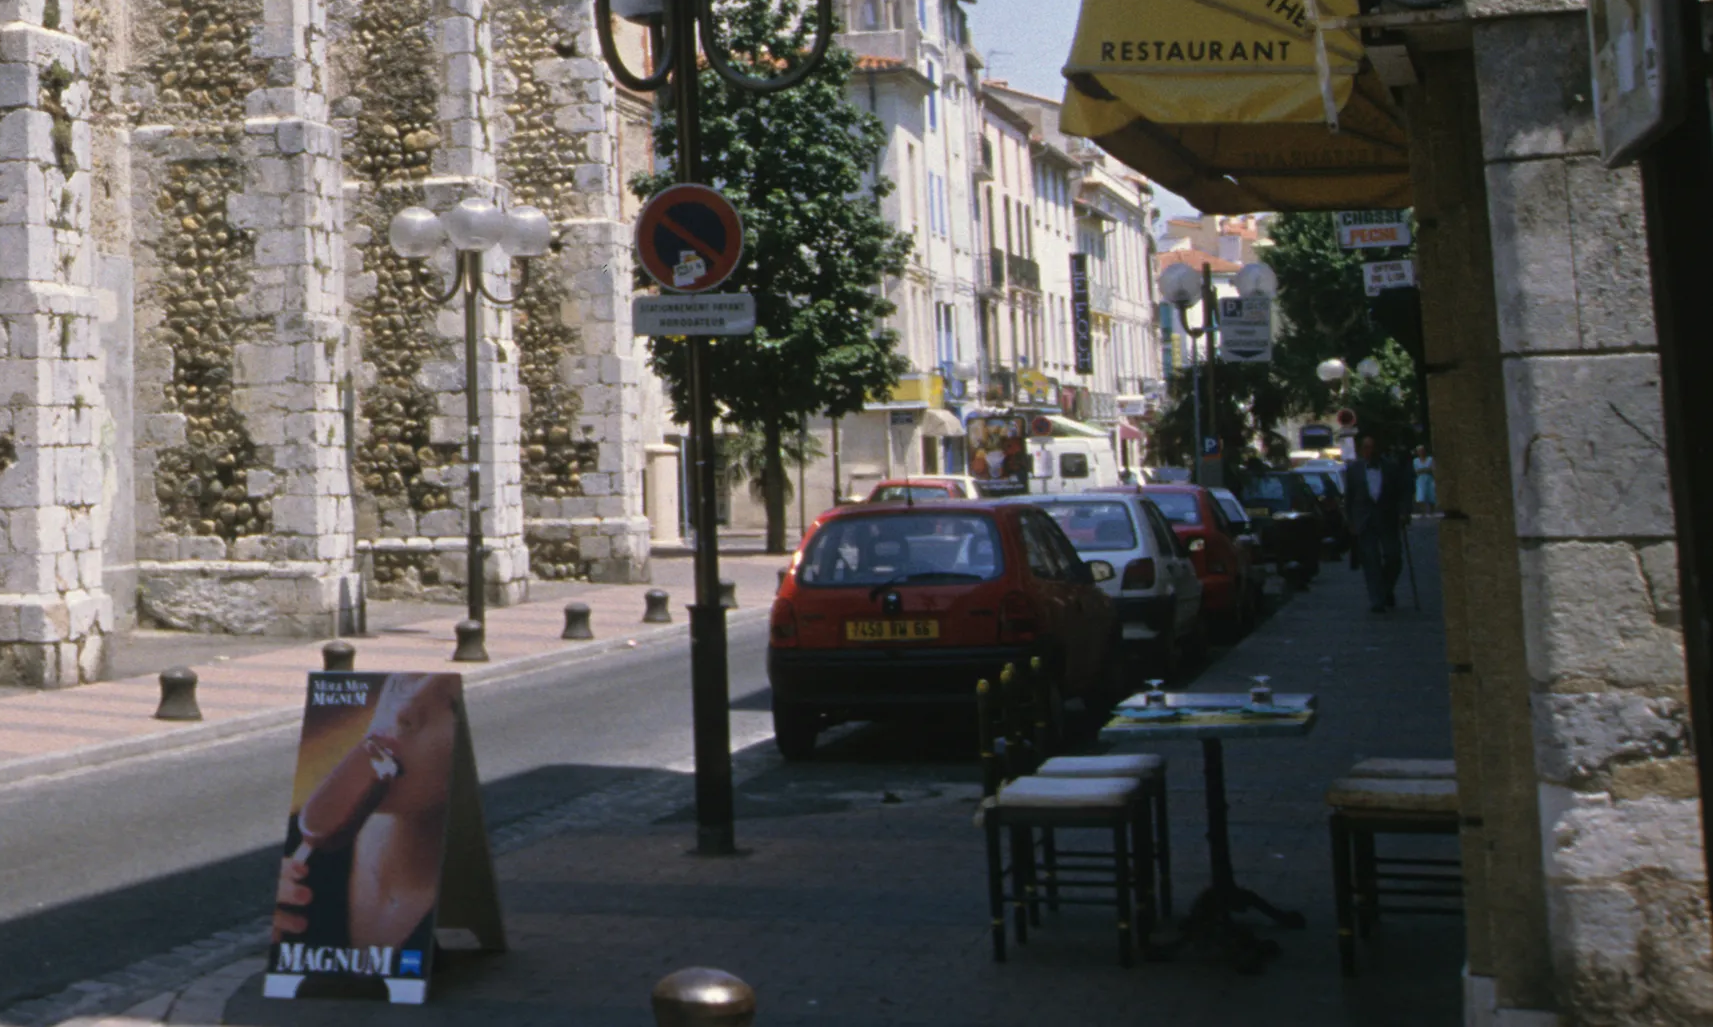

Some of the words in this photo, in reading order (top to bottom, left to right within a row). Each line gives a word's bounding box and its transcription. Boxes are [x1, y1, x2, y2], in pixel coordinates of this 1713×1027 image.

[1101, 40, 1290, 62] RESTAURANT
[1072, 259, 1087, 293] LE
[1074, 302, 1091, 369] FOCH
[312, 692, 367, 706] MAGNUM
[276, 942, 393, 976] MAGNUM
